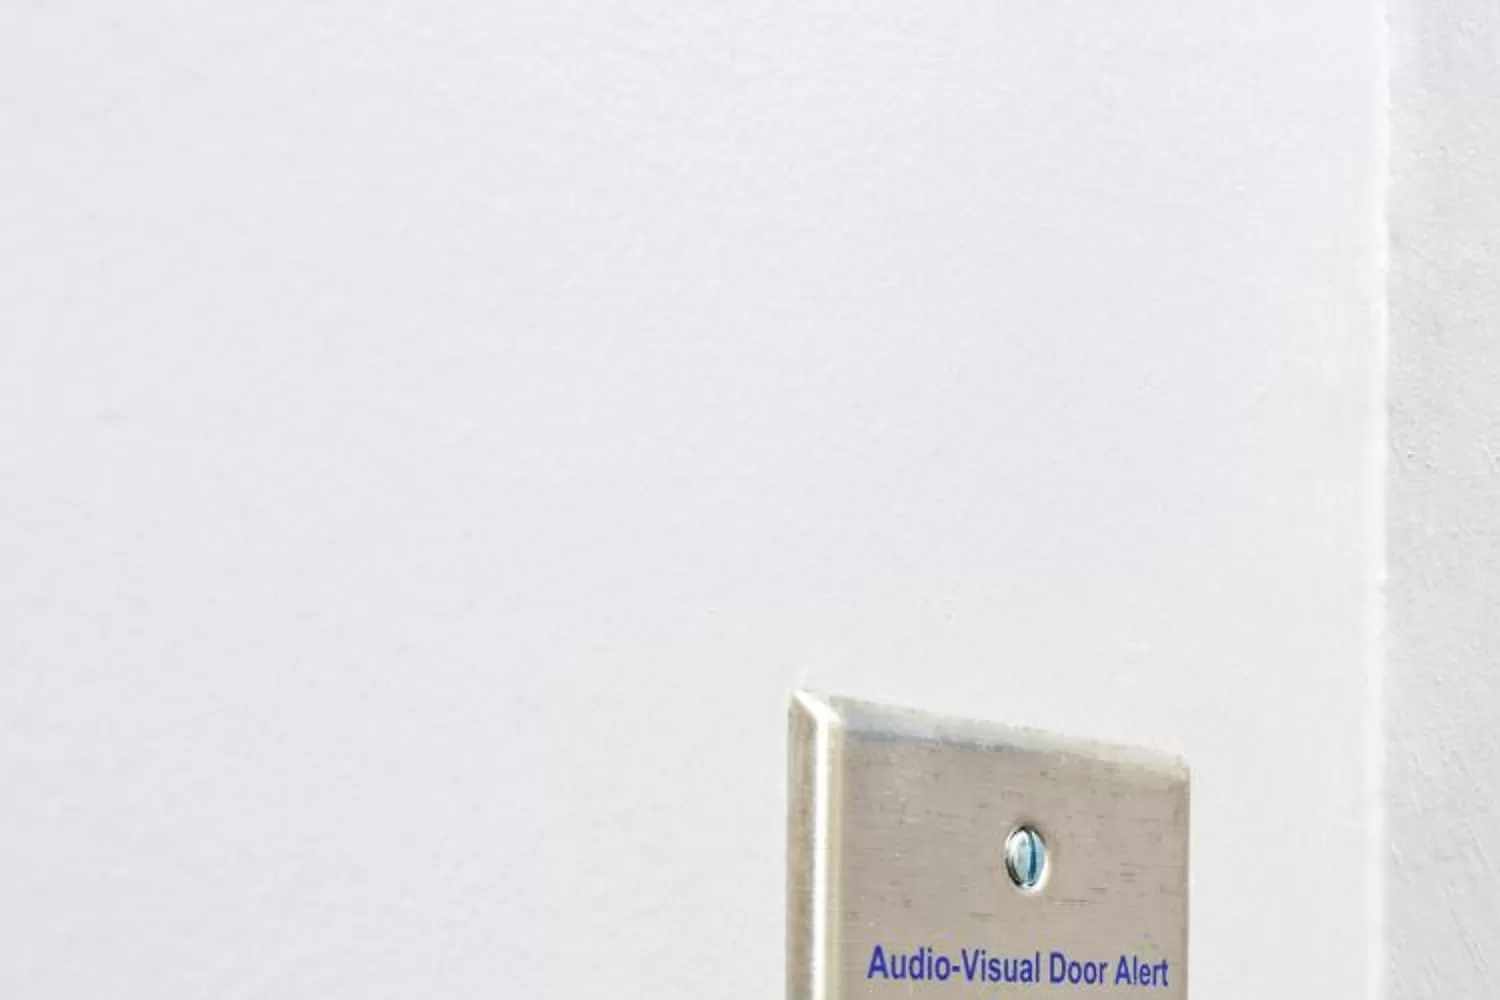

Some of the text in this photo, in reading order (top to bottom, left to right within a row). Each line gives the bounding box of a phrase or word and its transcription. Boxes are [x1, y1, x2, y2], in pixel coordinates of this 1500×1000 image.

[867, 943, 1170, 988] Audio-Visual Door Alert
